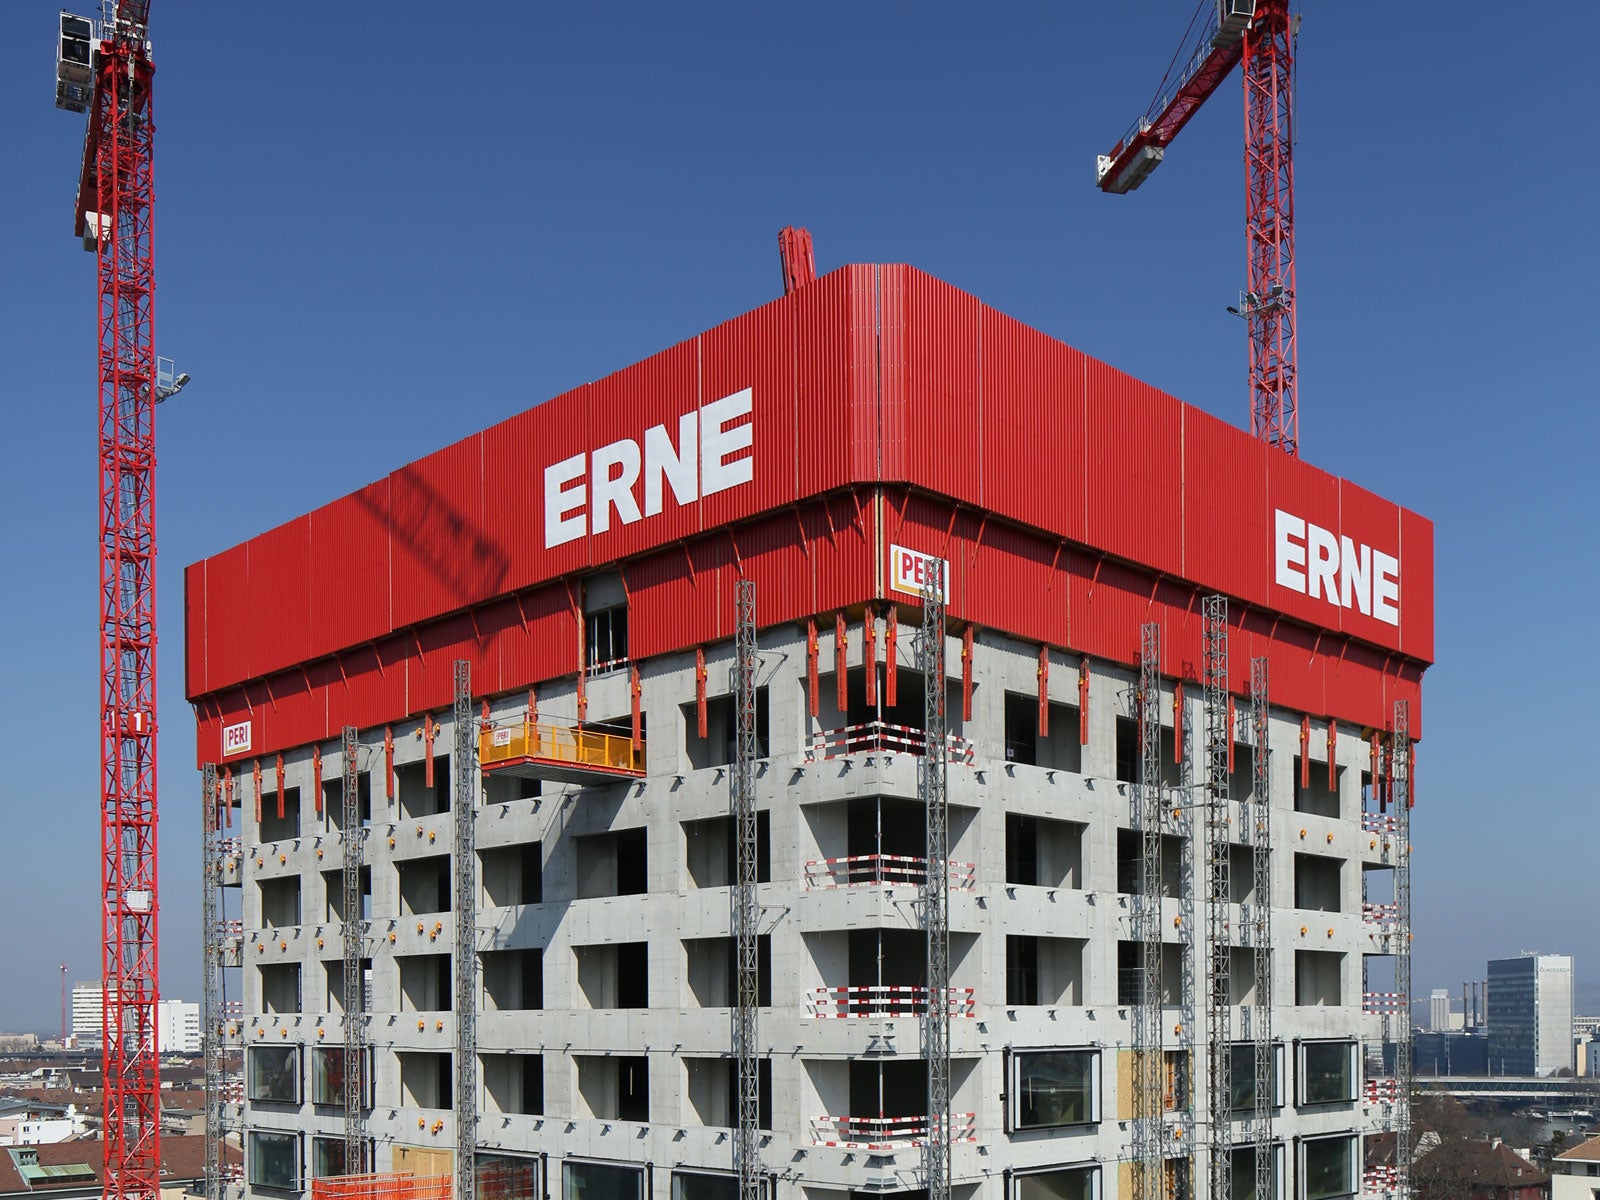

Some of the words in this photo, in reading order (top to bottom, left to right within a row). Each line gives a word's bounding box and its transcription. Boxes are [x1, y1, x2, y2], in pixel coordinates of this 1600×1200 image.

[544, 387, 753, 549] ERNE
[1275, 508, 1399, 626] ERNE
[133, 712, 142, 731] 1
[228, 725, 248, 747] PERI
